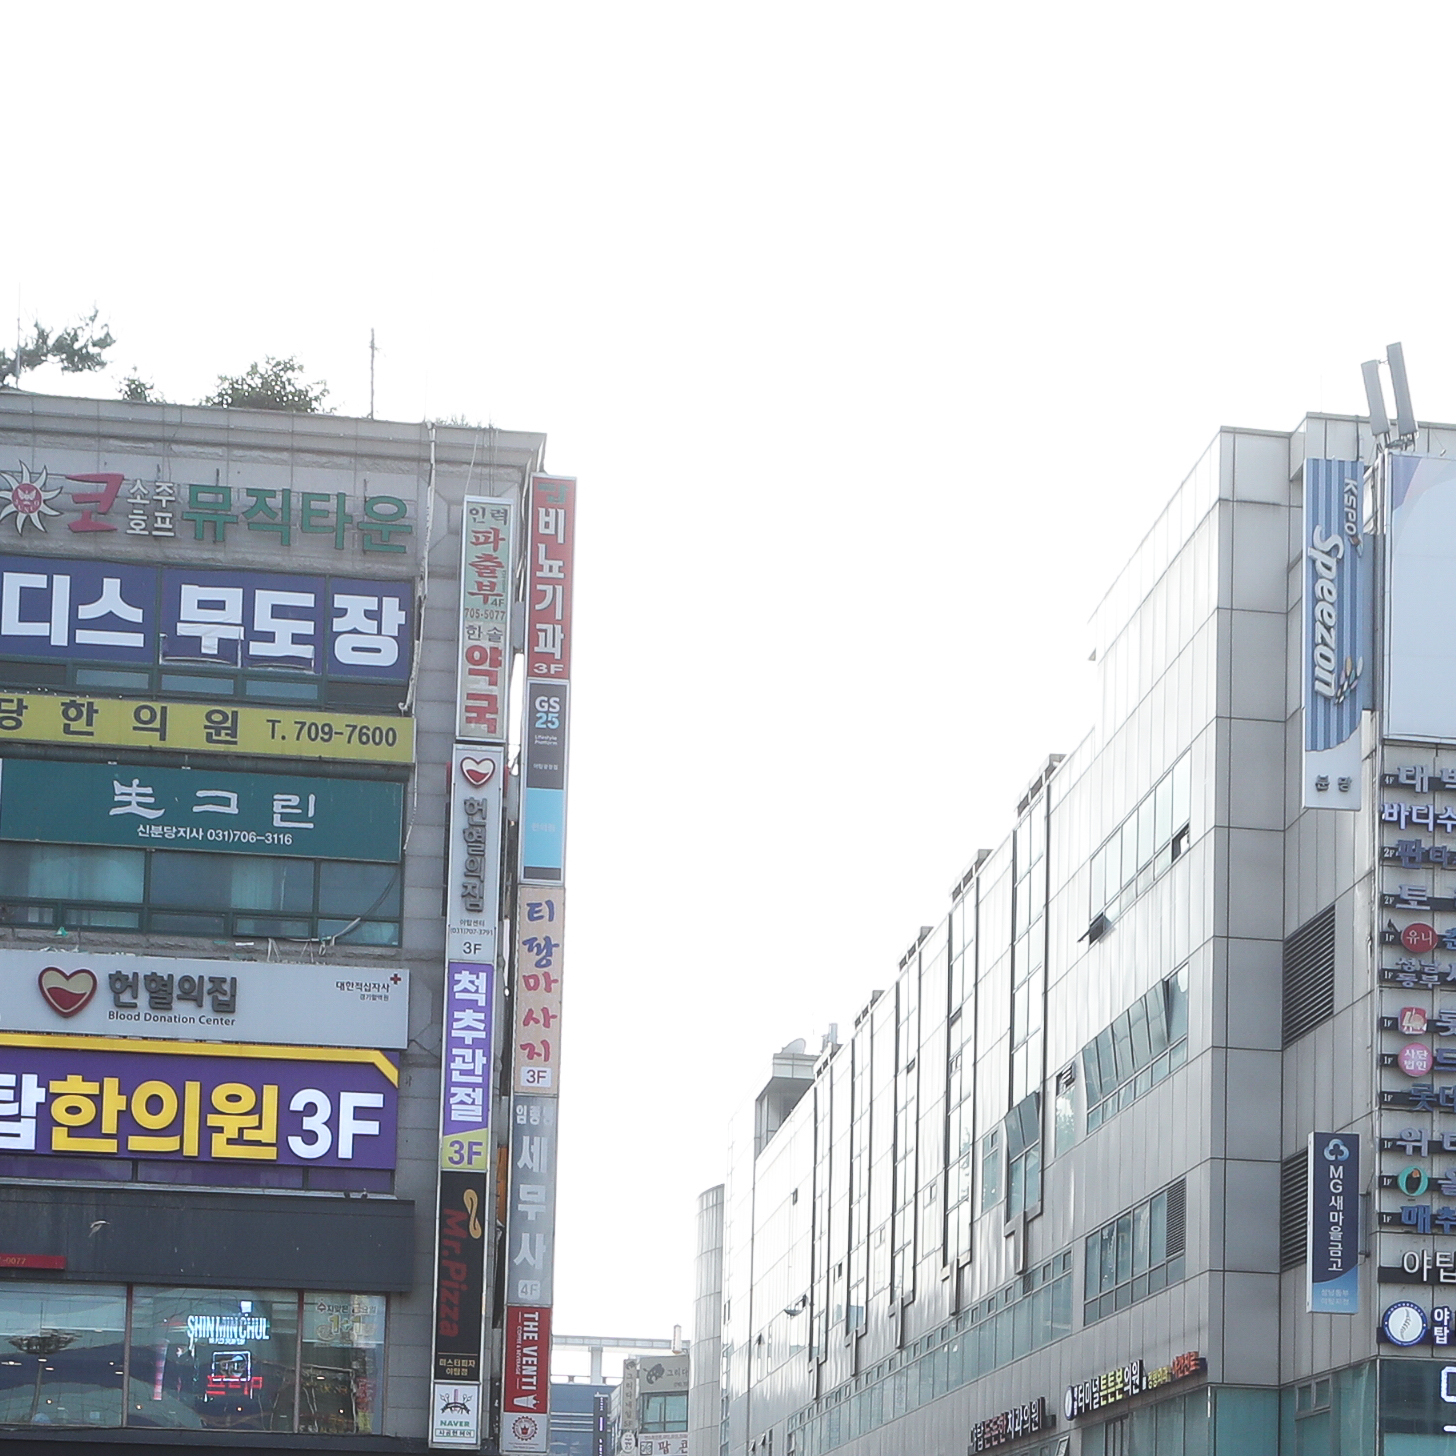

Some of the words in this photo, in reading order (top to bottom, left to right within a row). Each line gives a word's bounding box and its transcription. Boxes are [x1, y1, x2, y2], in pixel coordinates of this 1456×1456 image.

[127, 478, 177, 508] 소주
[127, 511, 176, 538] 호프
[182, 484, 414, 554] 뮤직타운
[469, 505, 509, 526] 인력
[467, 526, 506, 605] 파출부
[533, 506, 566, 661] 비뇨기과
[176, 583, 407, 668] 무도장
[465, 624, 504, 644] 한솔
[533, 663, 564, 675] 3F
[465, 644, 504, 735] 약국
[534, 695, 562, 713] GS
[294, 720, 398, 749] 709-7600
[534, 712, 561, 729] 25
[136, 823, 204, 842] 신분당지사
[207, 828, 294, 846] 031)706-3116
[460, 797, 488, 914] 헌혈의집
[462, 941, 482, 956] 3F
[1405, 929, 1433, 945] 유니
[107, 969, 238, 1014] 헌혈의집
[107, 1010, 141, 1024] Blood
[143, 1012, 196, 1026] Donation
[198, 1014, 236, 1027] Center
[520, 971, 559, 1063] 마사지
[449, 969, 488, 1123] 척추관절
[526, 1069, 547, 1085] 3F
[287, 1088, 384, 1160] 3F
[447, 1138, 484, 1167] 3F
[513, 1135, 547, 1271] 세무사
[438, 1207, 469, 1339] Mr.Pizza
[522, 1311, 540, 1342] THE
[521, 1342, 540, 1391] VENTI
[439, 1419, 470, 1428] NAVER
